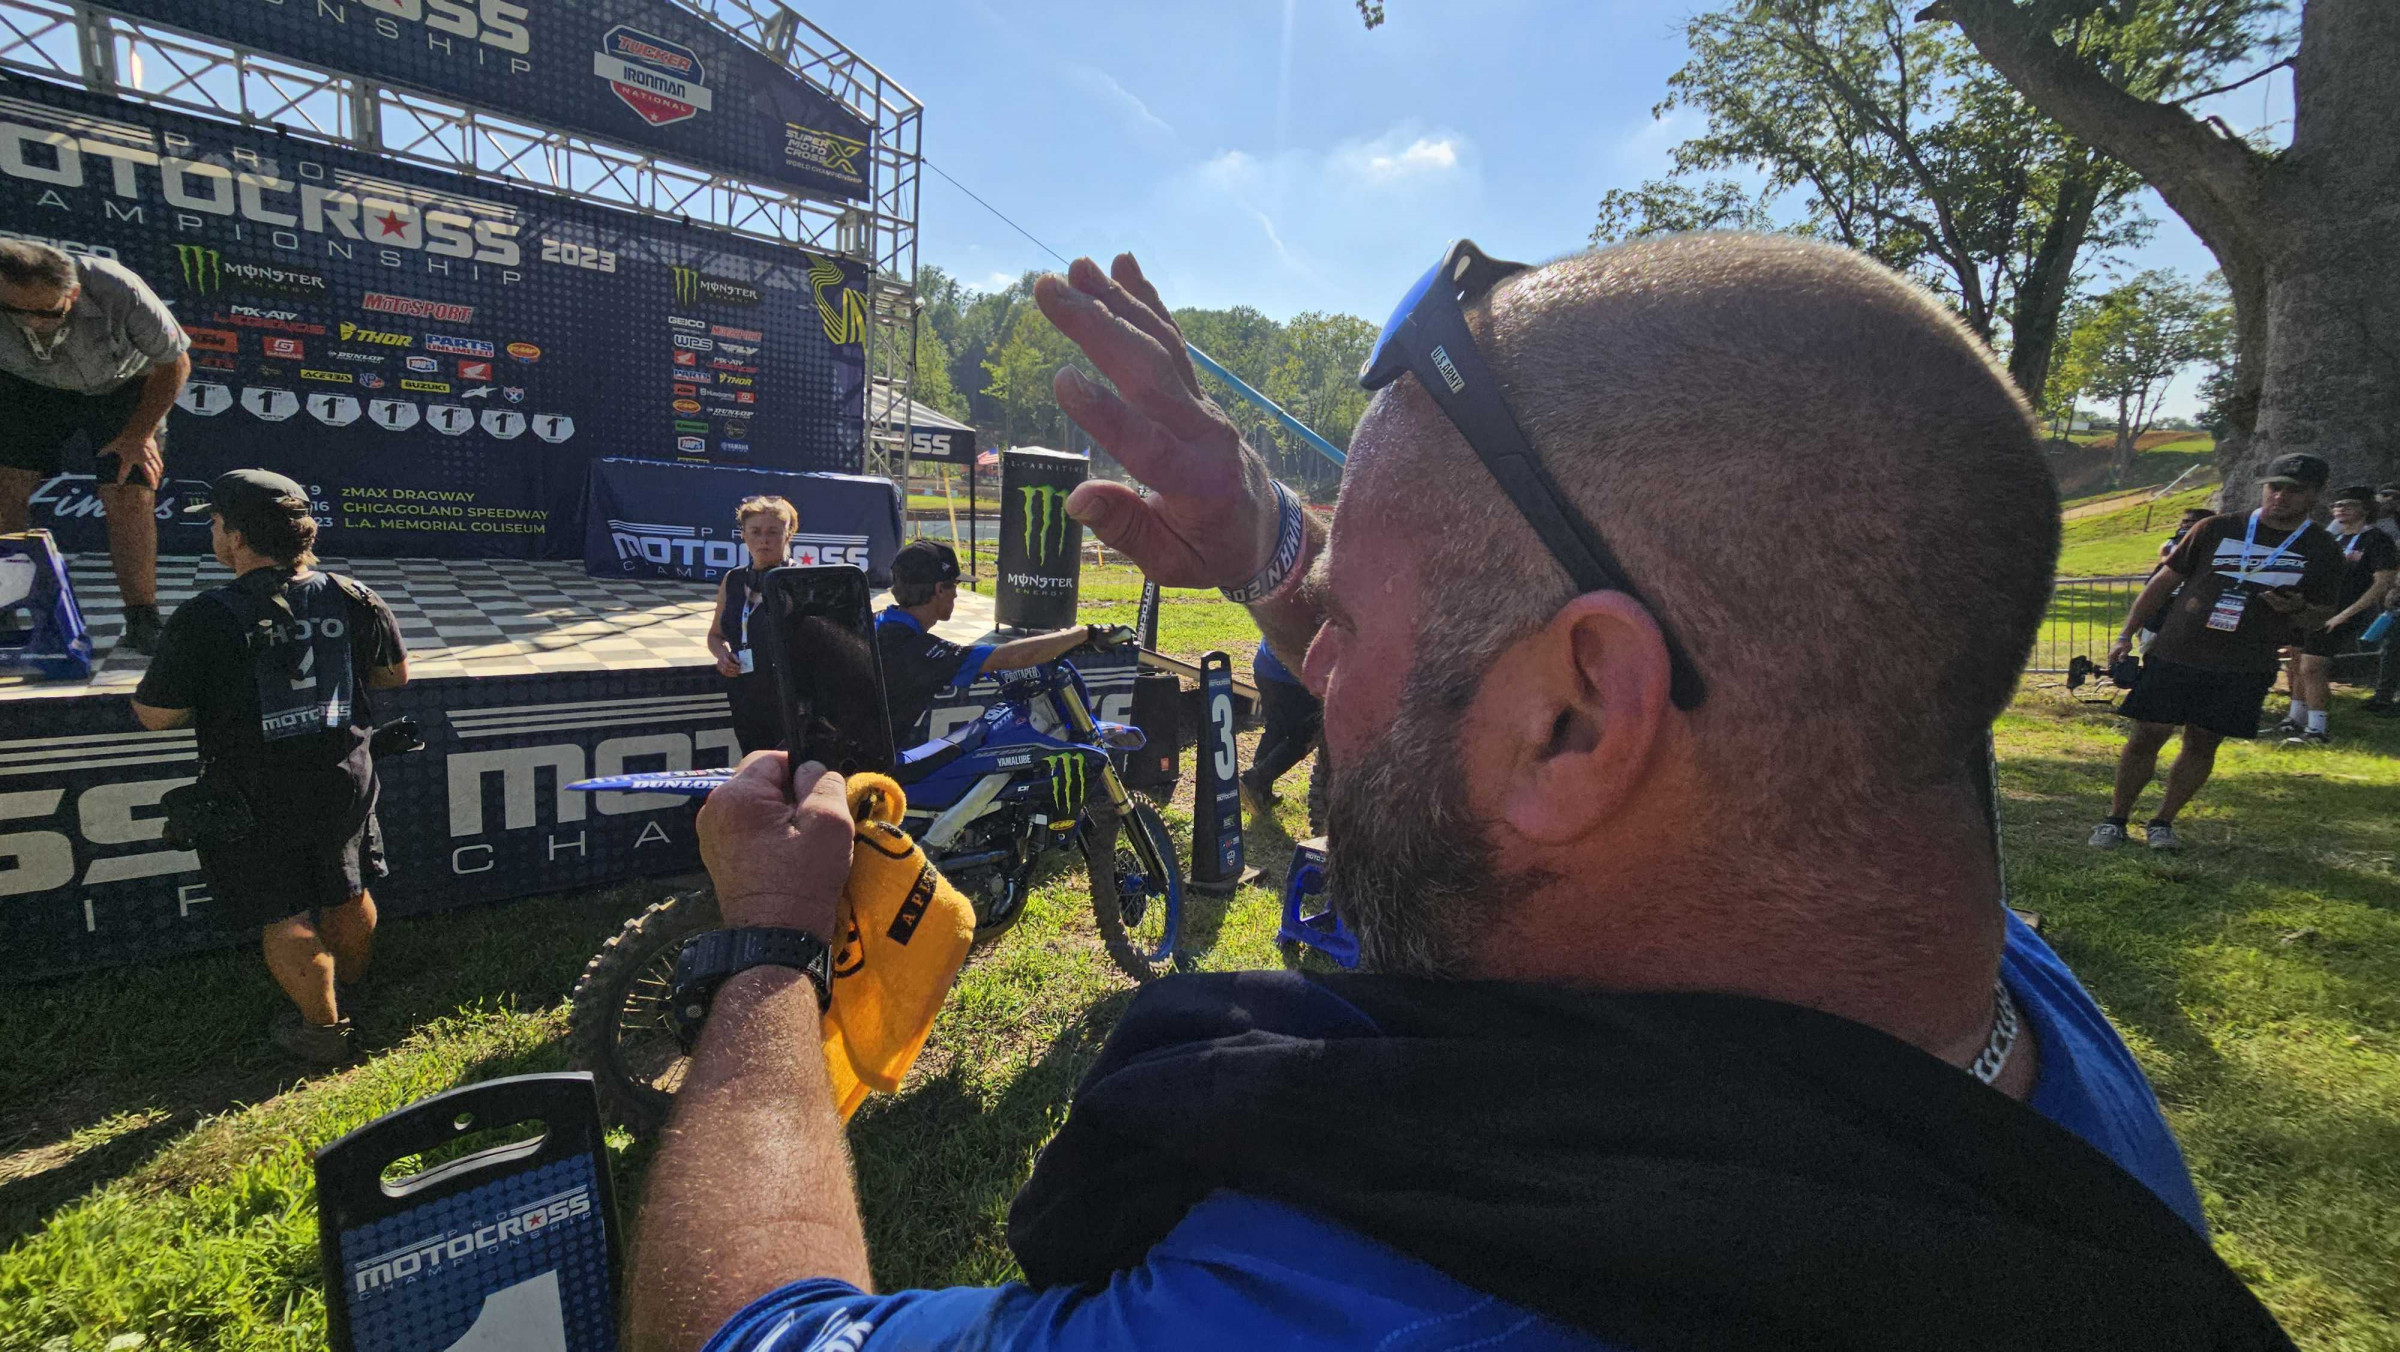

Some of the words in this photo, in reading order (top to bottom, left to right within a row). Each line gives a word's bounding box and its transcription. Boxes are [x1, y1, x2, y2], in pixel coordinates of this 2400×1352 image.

[617, 33, 693, 72] TUCKER
[623, 66, 686, 99] IRONMAN
[621, 86, 687, 113] NATIONAL
[785, 129, 829, 148] SUPER
[787, 138, 828, 156] MOTO
[784, 146, 828, 165] CROSS
[541, 239, 617, 273] 2023
[668, 316, 706, 329] GEICO
[355, 329, 413, 347] THOR
[427, 335, 493, 351] PARTS
[674, 334, 713, 351] WPS
[338, 351, 385, 361] DUNLOP
[410, 360, 436, 370] 100%
[404, 382, 447, 391] SUZUKI
[727, 376, 752, 386] THOR
[713, 407, 754, 416] DUNLOP
[311, 485, 321, 496] 9
[341, 487, 388, 499] zMAX
[392, 489, 475, 502] DRAGWAY
[343, 502, 464, 517] CHICAGOLAND
[467, 507, 549, 520] SPEEDWAY
[344, 519, 376, 529] L.A.
[381, 519, 467, 532] MEMORIAL
[471, 522, 546, 534] COLISEUM
[1004, 666, 1038, 683] PROTAPER
[1212, 693, 1235, 781] 3
[997, 754, 1032, 767] YAMALUBE
[447, 1211, 507, 1237] PRO
[355, 1192, 590, 1294] MOTOCROSS
[358, 1211, 592, 1301] CHAMPIONSHIP
